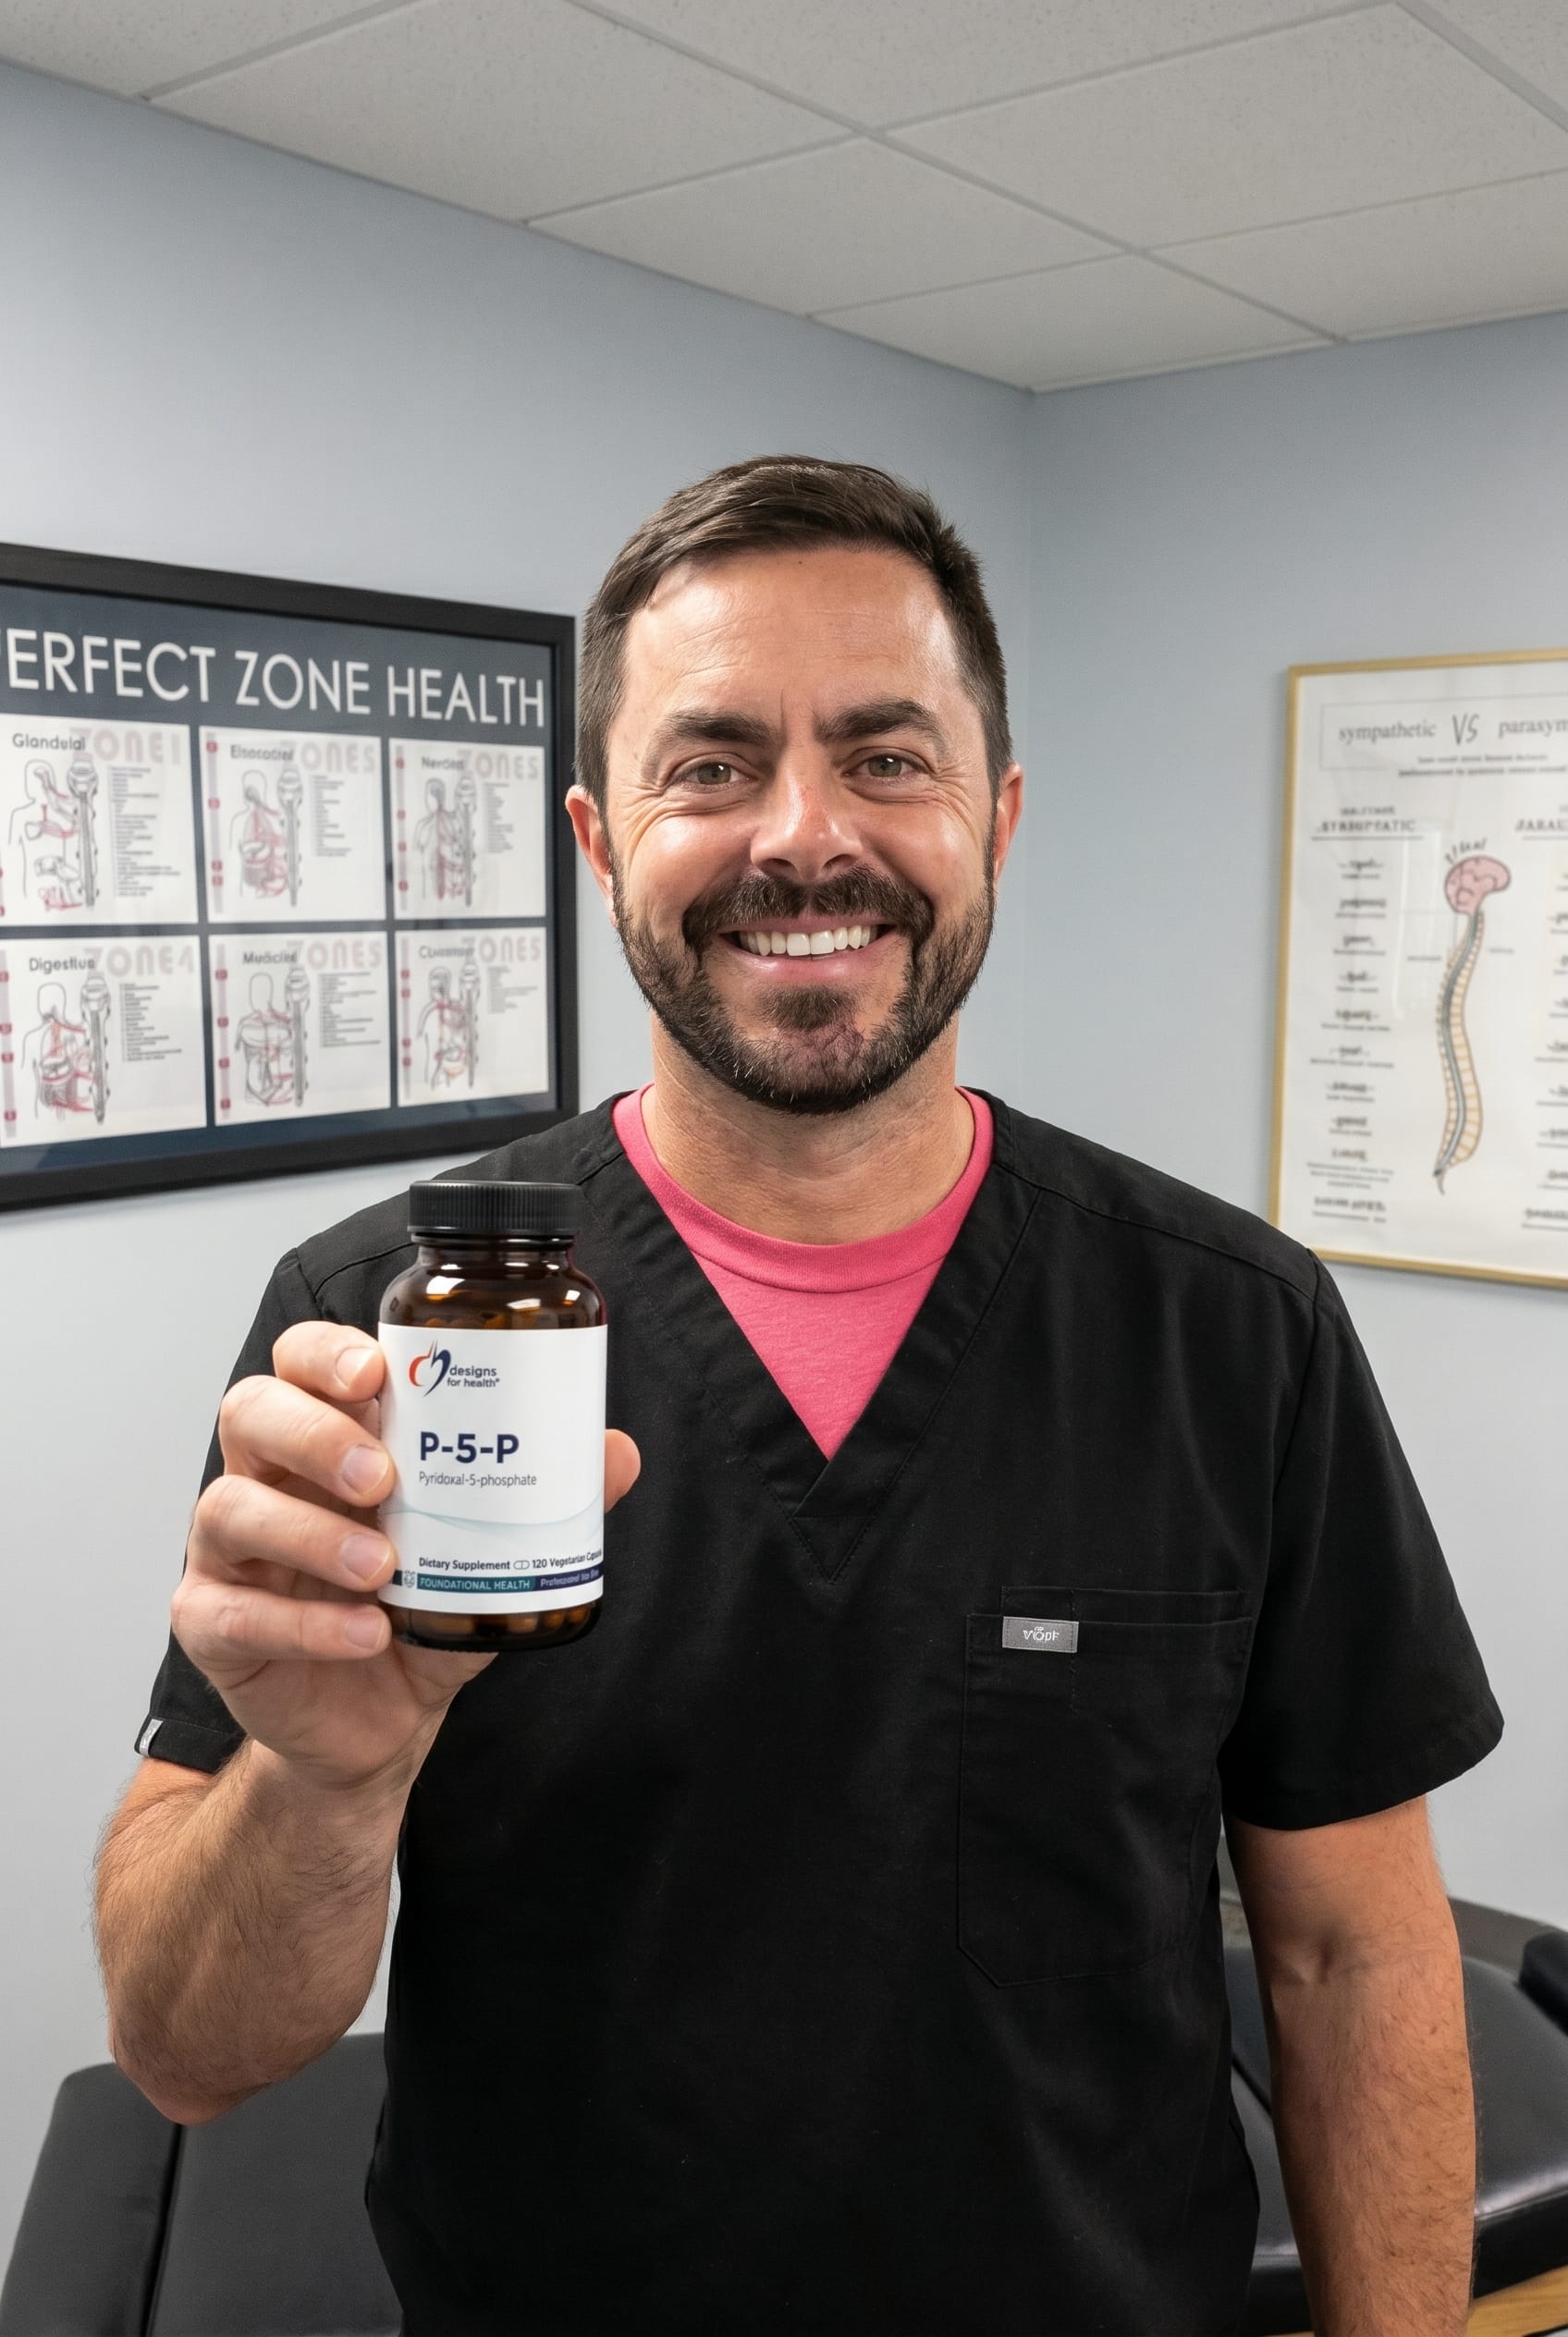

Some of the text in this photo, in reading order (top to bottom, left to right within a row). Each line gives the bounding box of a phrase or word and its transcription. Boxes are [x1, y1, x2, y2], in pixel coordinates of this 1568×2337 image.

[0, 628, 545, 728] ERFECT ZONE HEALTH
[1339, 720, 1437, 745] sympathetic
[1451, 713, 1480, 746] VS
[449, 1365, 497, 1378] designs
[447, 1377, 461, 1387] for
[420, 1431, 520, 1464] P-5-P
[419, 1471, 537, 1488] Pyridoxal-5-phosphate
[452, 1560, 510, 1571] Supplement
[532, 1559, 547, 1569] 120
[420, 1577, 531, 1590] FOUNDATIONAL HEALTH
